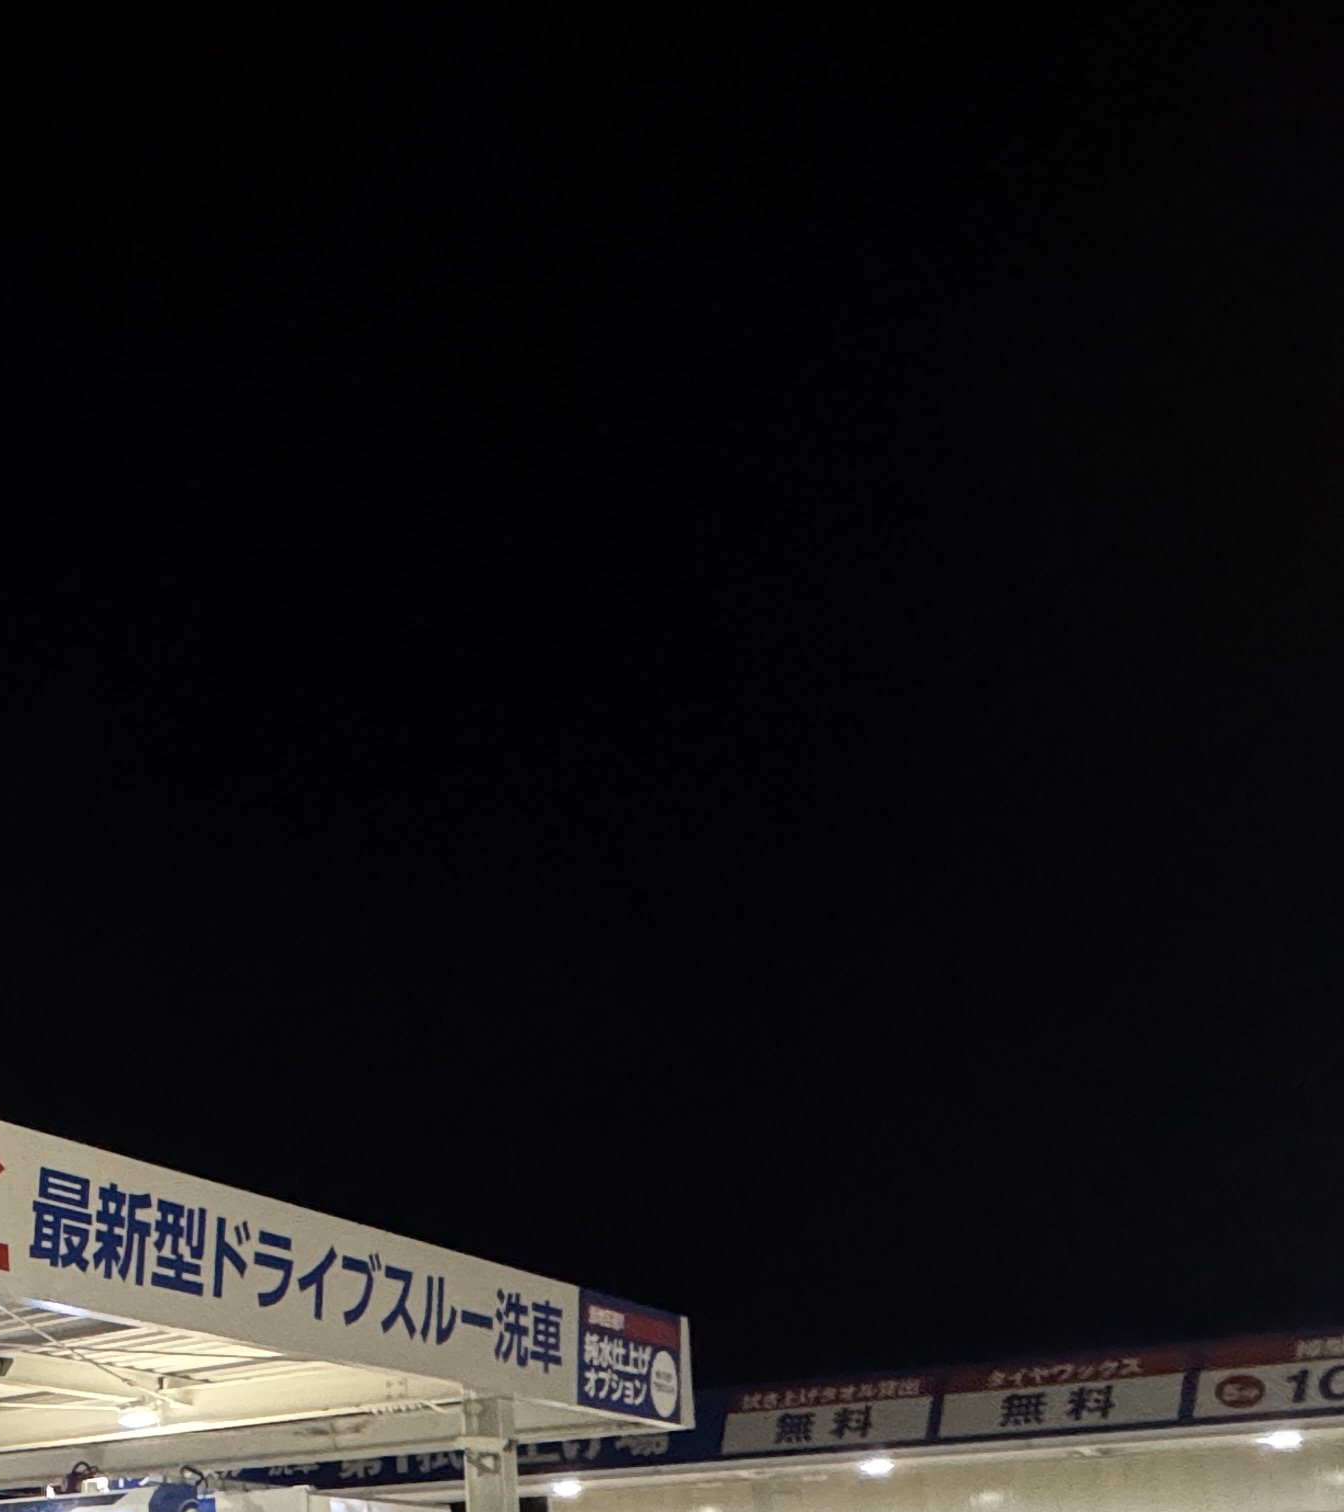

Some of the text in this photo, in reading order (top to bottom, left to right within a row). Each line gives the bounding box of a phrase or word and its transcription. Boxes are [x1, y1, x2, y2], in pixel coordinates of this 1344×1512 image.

[28, 1165, 563, 1374] 最新型ドライブスルー洗車
[583, 1367, 648, 1406] オプション
[999, 1384, 1115, 1427] 無料
[774, 1404, 873, 1444] 無料
